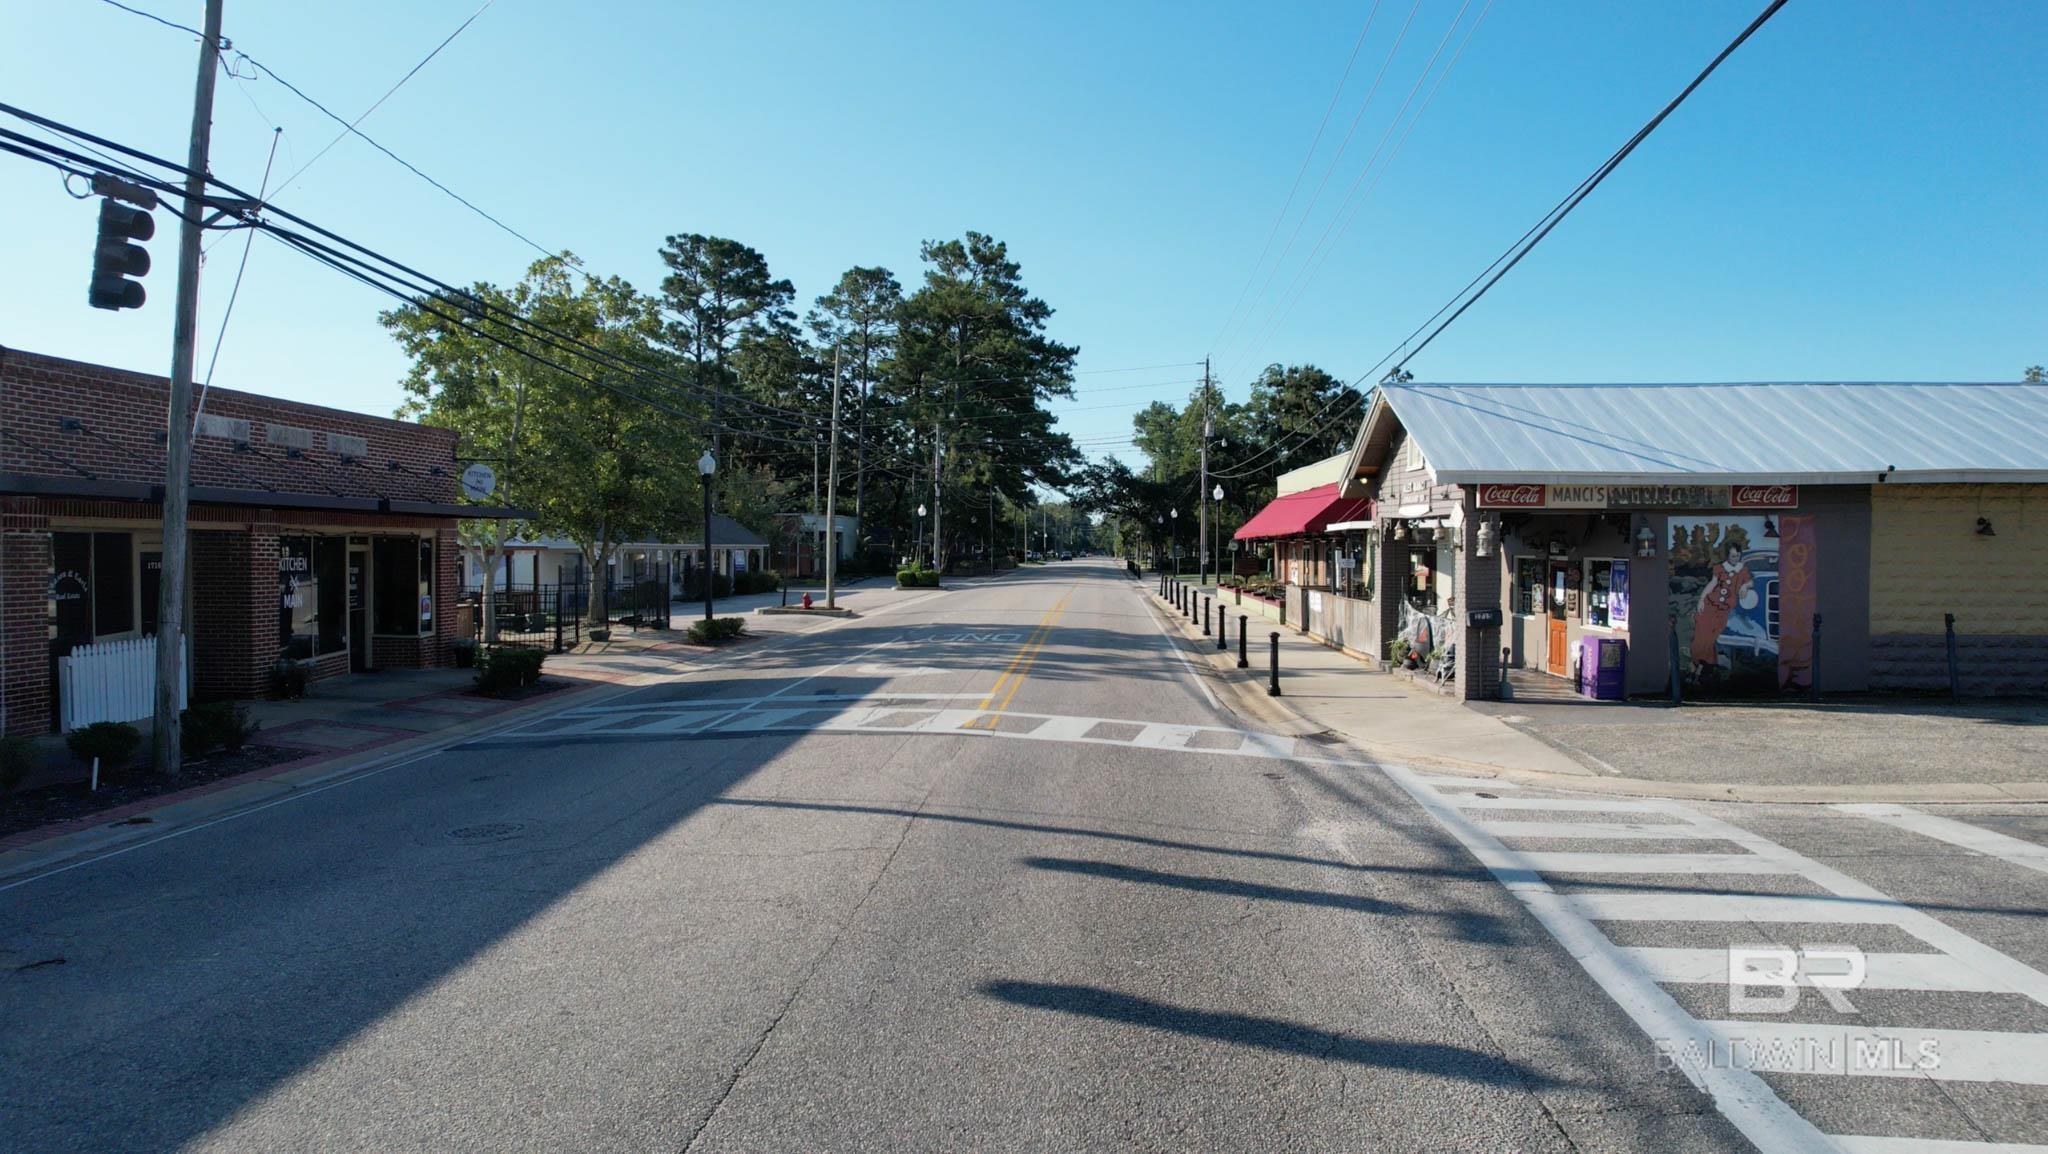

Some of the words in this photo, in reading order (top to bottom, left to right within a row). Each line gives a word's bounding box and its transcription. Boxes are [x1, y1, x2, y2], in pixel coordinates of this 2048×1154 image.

[1484, 485, 1541, 504] Coca-Cola
[1552, 486, 1606, 503] MANCI'S
[1736, 485, 1794, 504] Coca-Cola
[279, 557, 307, 571] KITCHEN
[283, 593, 304, 608] MAIN
